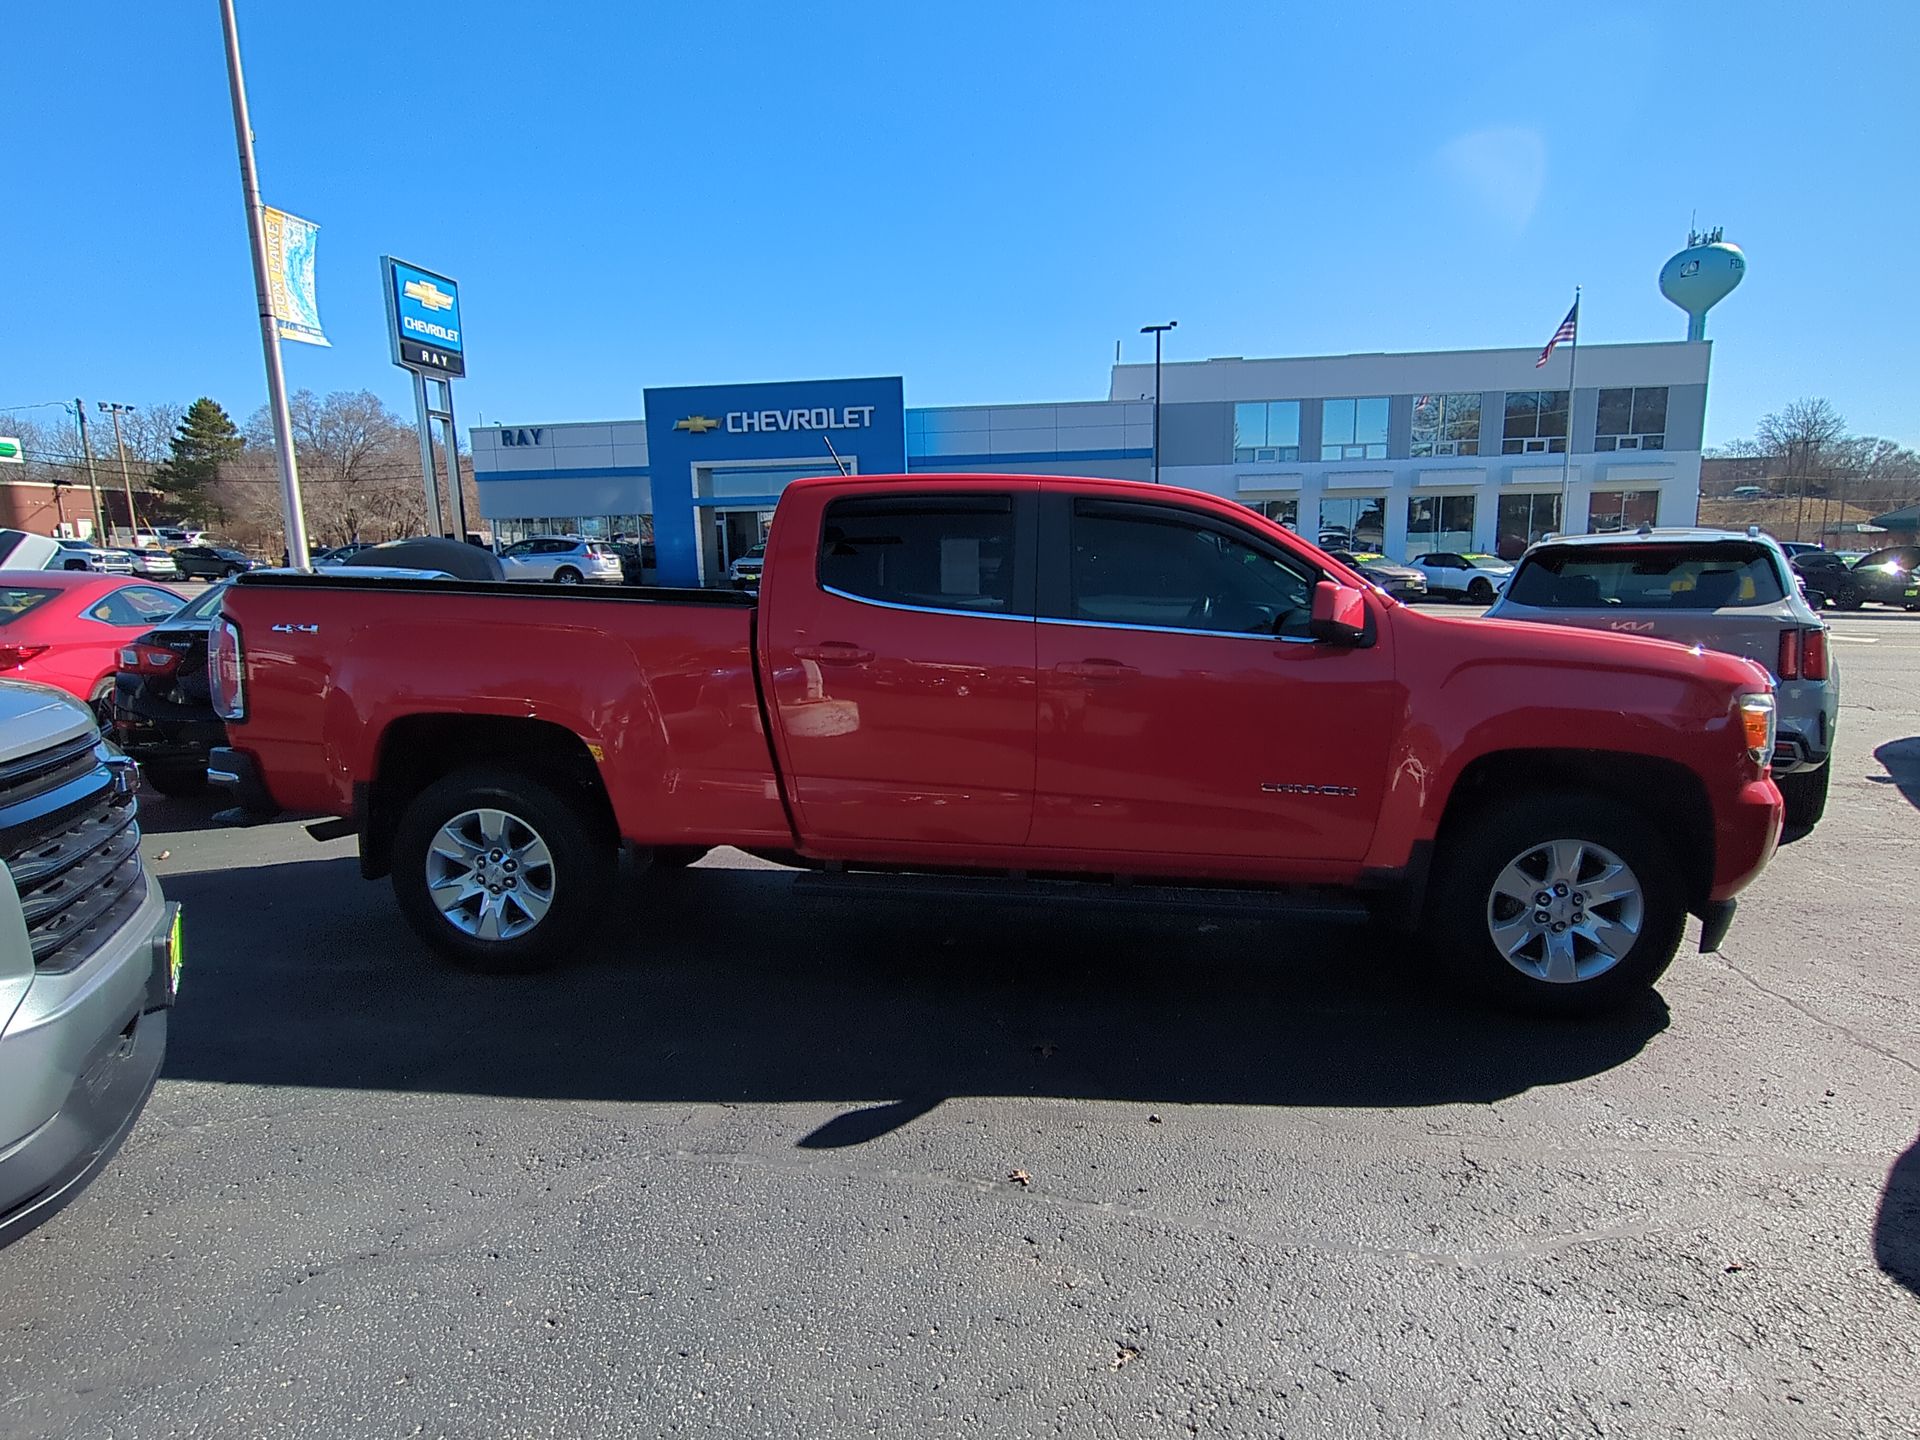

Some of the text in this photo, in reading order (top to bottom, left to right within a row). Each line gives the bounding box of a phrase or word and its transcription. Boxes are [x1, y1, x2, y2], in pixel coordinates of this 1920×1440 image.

[268, 221, 290, 318] FOX LAKE
[403, 316, 459, 342] CHEVROLET
[421, 350, 448, 367] RAY
[726, 406, 875, 433] CHEVROLET
[501, 428, 543, 447] RAY
[1611, 621, 1655, 631] KIA
